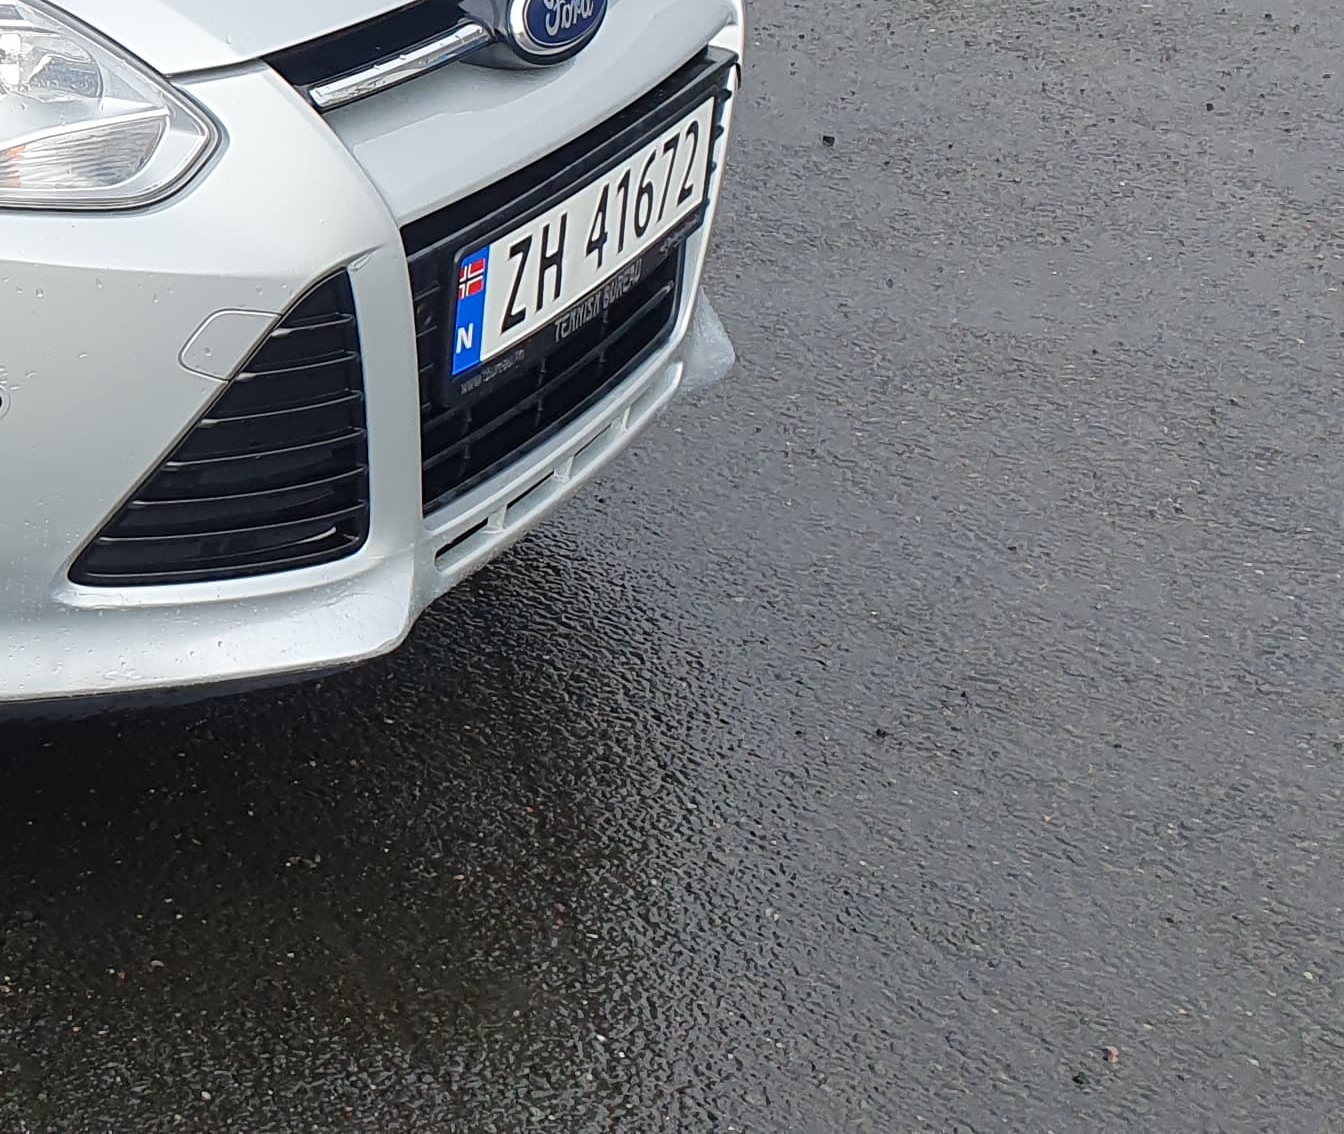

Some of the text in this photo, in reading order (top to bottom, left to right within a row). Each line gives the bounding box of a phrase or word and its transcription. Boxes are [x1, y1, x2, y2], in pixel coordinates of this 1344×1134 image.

[500, 120, 700, 335] ZH 41672
[456, 323, 474, 354] N
